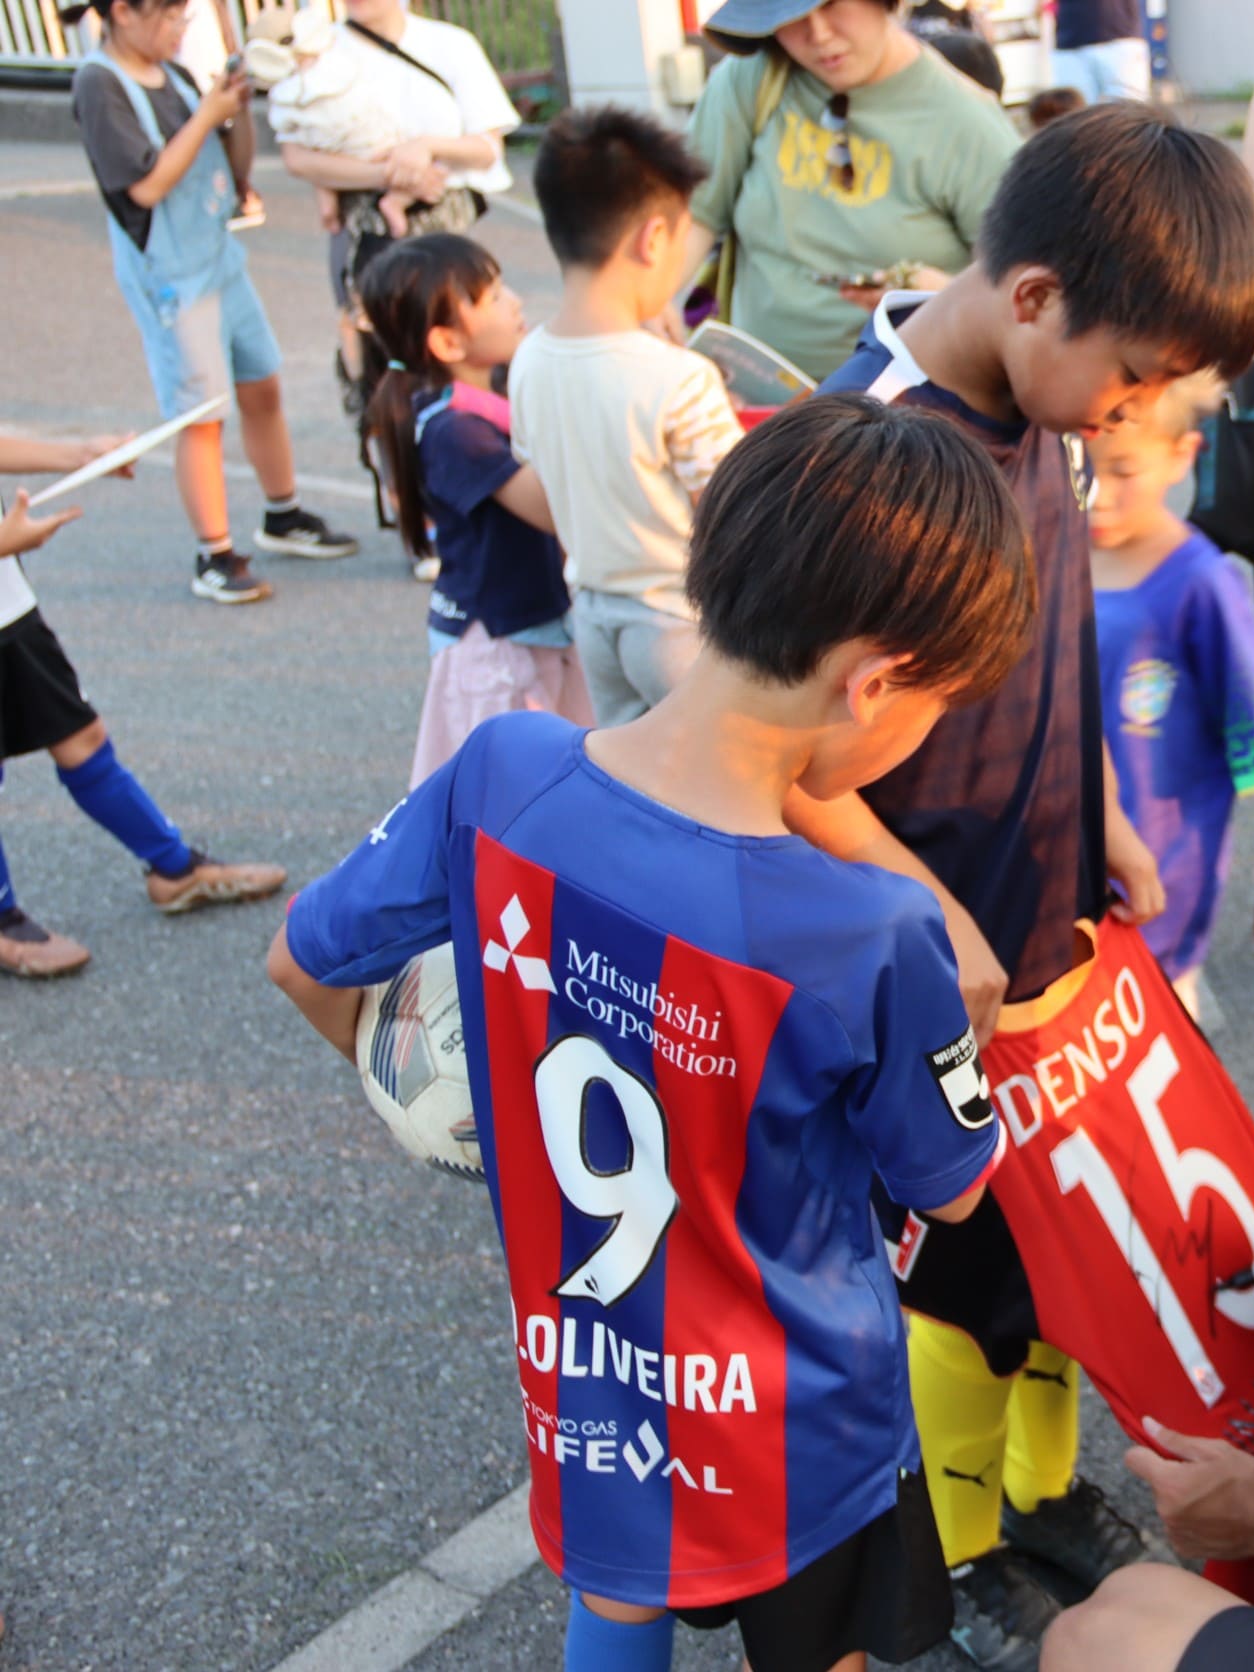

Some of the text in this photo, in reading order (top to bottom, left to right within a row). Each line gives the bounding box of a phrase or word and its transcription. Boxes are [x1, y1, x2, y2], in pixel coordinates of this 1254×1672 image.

[564, 976, 737, 1077] Corporation
[566, 937, 722, 1042] Mitsubishi
[994, 966, 1146, 1148] DENSO
[533, 1032, 680, 1309] 9
[511, 1296, 757, 1414] .OLIVEIRA
[529, 1403, 617, 1436] TOKYO GAS
